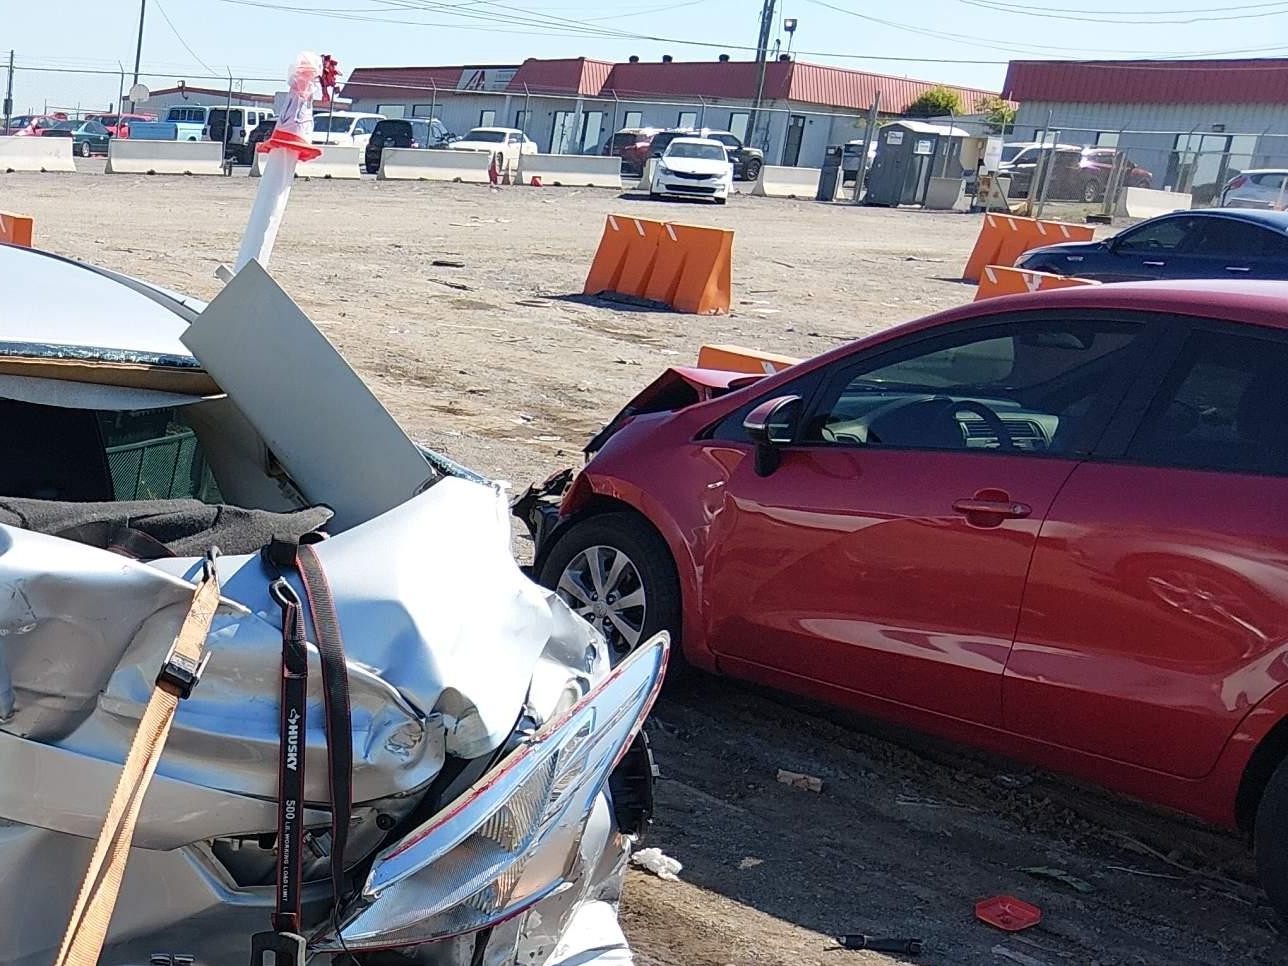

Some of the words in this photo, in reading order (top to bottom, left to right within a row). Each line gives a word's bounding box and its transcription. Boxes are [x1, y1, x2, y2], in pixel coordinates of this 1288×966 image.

[287, 725, 299, 771] HUSKY
[285, 800, 296, 819] 500
[282, 834, 291, 864] WORKING
